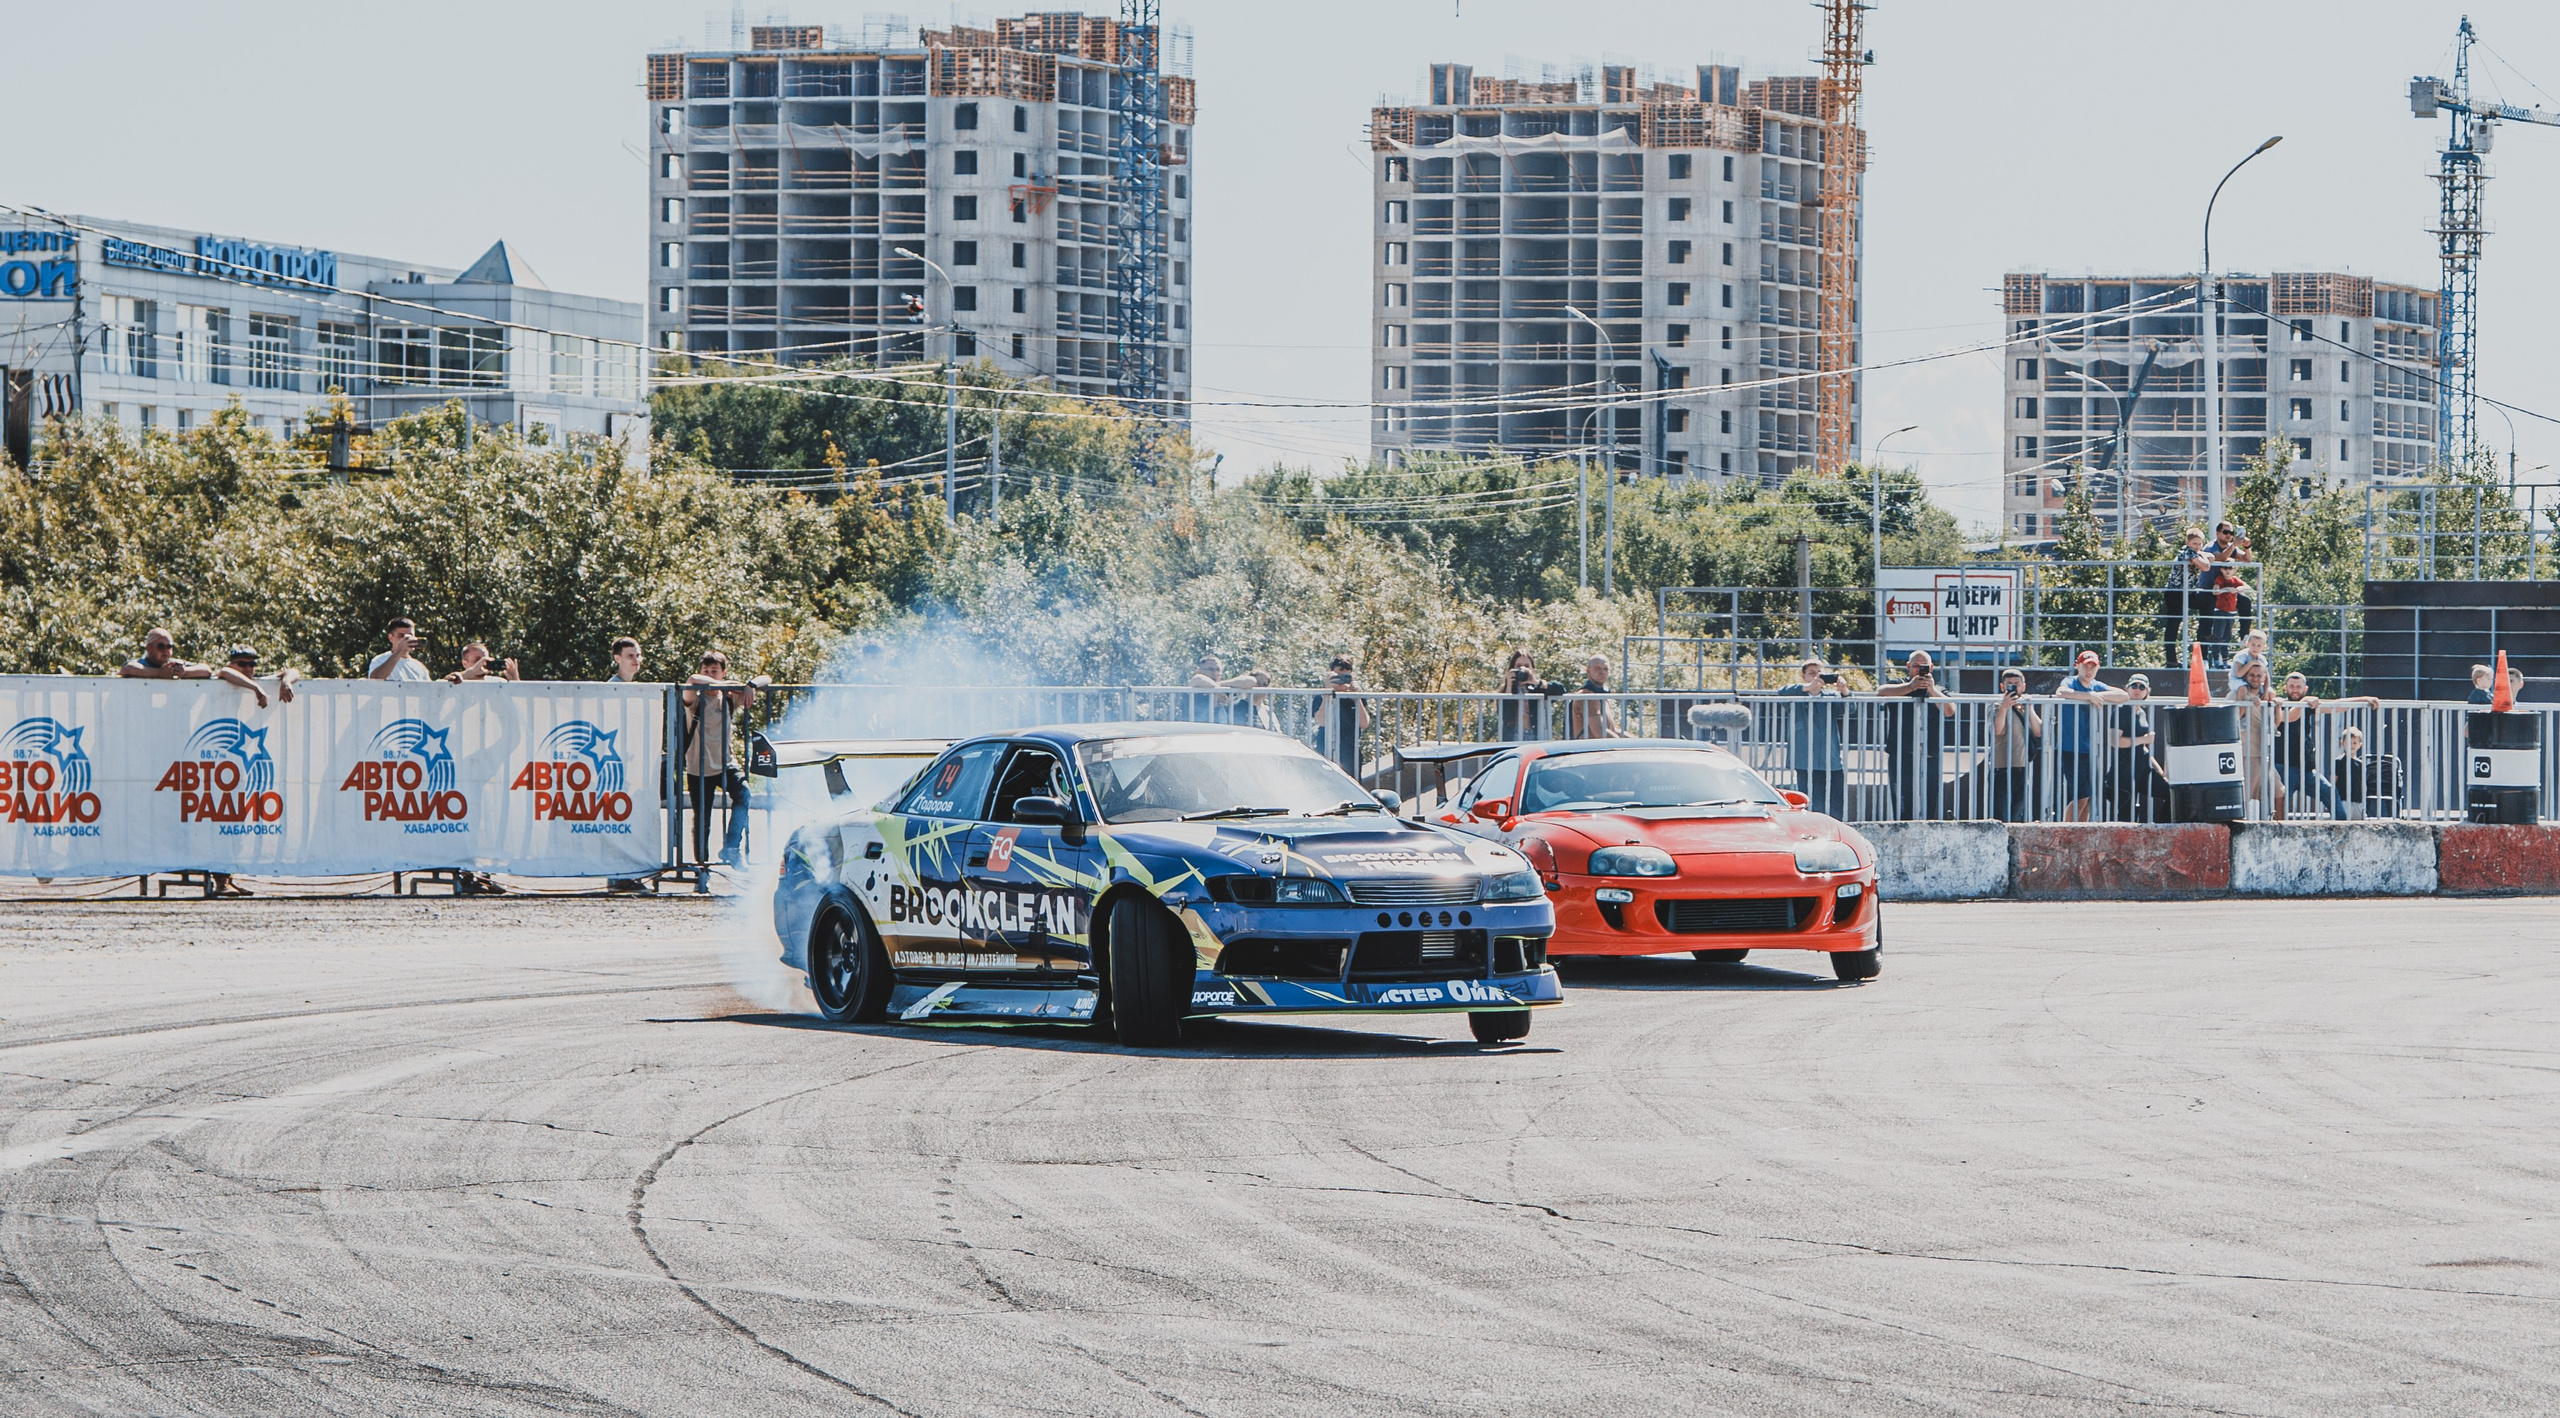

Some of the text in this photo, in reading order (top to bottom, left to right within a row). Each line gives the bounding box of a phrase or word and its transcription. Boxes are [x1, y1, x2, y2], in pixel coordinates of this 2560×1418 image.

[202, 236, 337, 287] НОВОСТРОЙ
[0, 254, 76, 296] ОЙ
[1893, 603, 1927, 615] ЗДЕСЬ
[1947, 615, 2000, 638] ЦНТР
[2220, 757, 2235, 769] FQ
[2475, 761, 2490, 773] FQ
[154, 761, 241, 791] АВТО
[339, 761, 422, 791] АВТО
[510, 761, 591, 791] АВТО
[937, 764, 960, 790] 14
[0, 792, 101, 823] РАДИО
[180, 792, 283, 822] РАДИО
[364, 791, 468, 821] РАДИО
[534, 791, 633, 821] РАДИО
[917, 796, 953, 814] Тодоров
[33, 825, 100, 837] ХАБАРОВСК
[219, 824, 283, 836] ХАБАРОВСК
[404, 822, 469, 834] ХАБАРОВСК
[571, 823, 632, 834] ХАБАРОВСК
[989, 837, 1013, 860] FQ
[1322, 852, 1463, 863] BROOKCLEAN
[890, 884, 1075, 935] BROOKCLEAN
[936, 952, 945, 965] ПО
[1192, 991, 1235, 1003] ДОРОГОЕ
